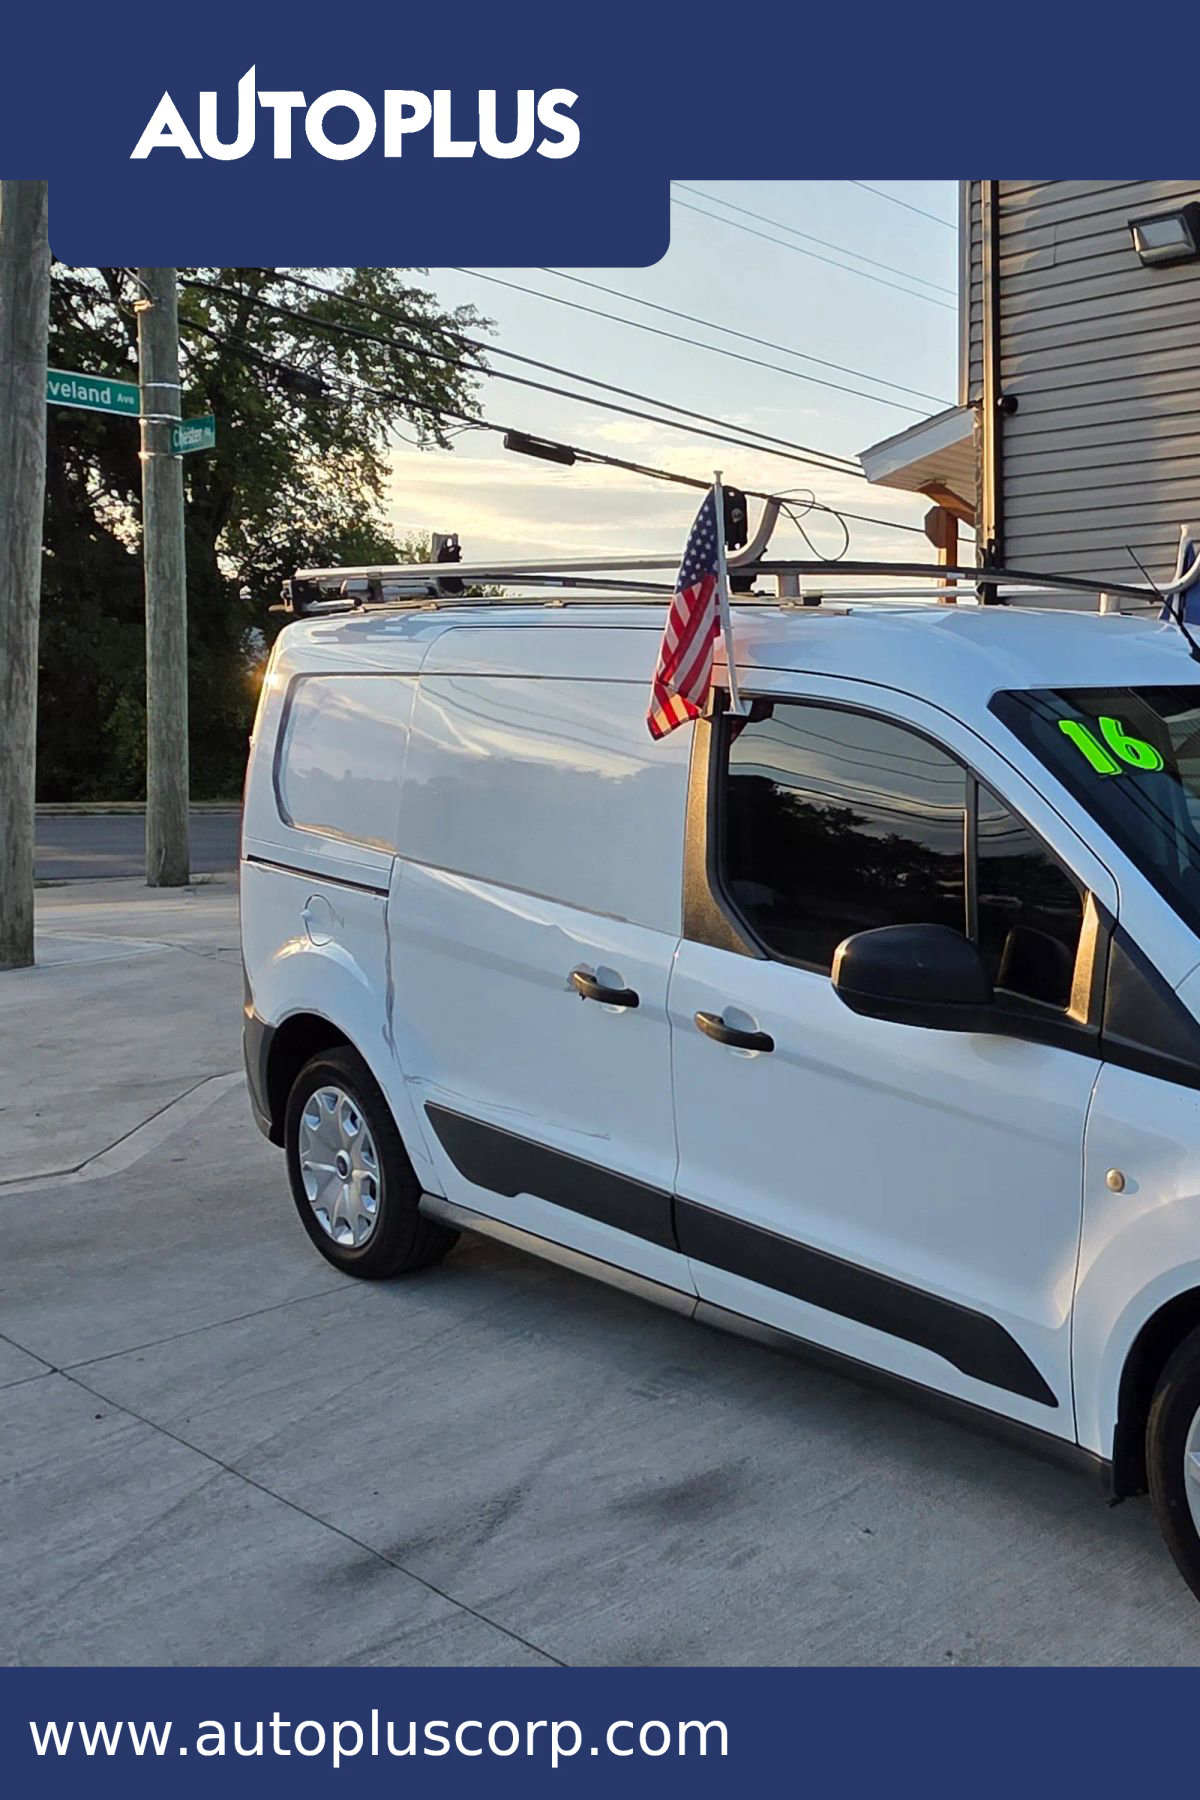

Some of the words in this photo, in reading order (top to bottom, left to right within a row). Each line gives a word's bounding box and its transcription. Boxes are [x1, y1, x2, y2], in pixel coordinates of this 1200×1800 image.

[46, 380, 112, 405] veland
[117, 393, 135, 406] Ave
[1058, 716, 1164, 775] 16
